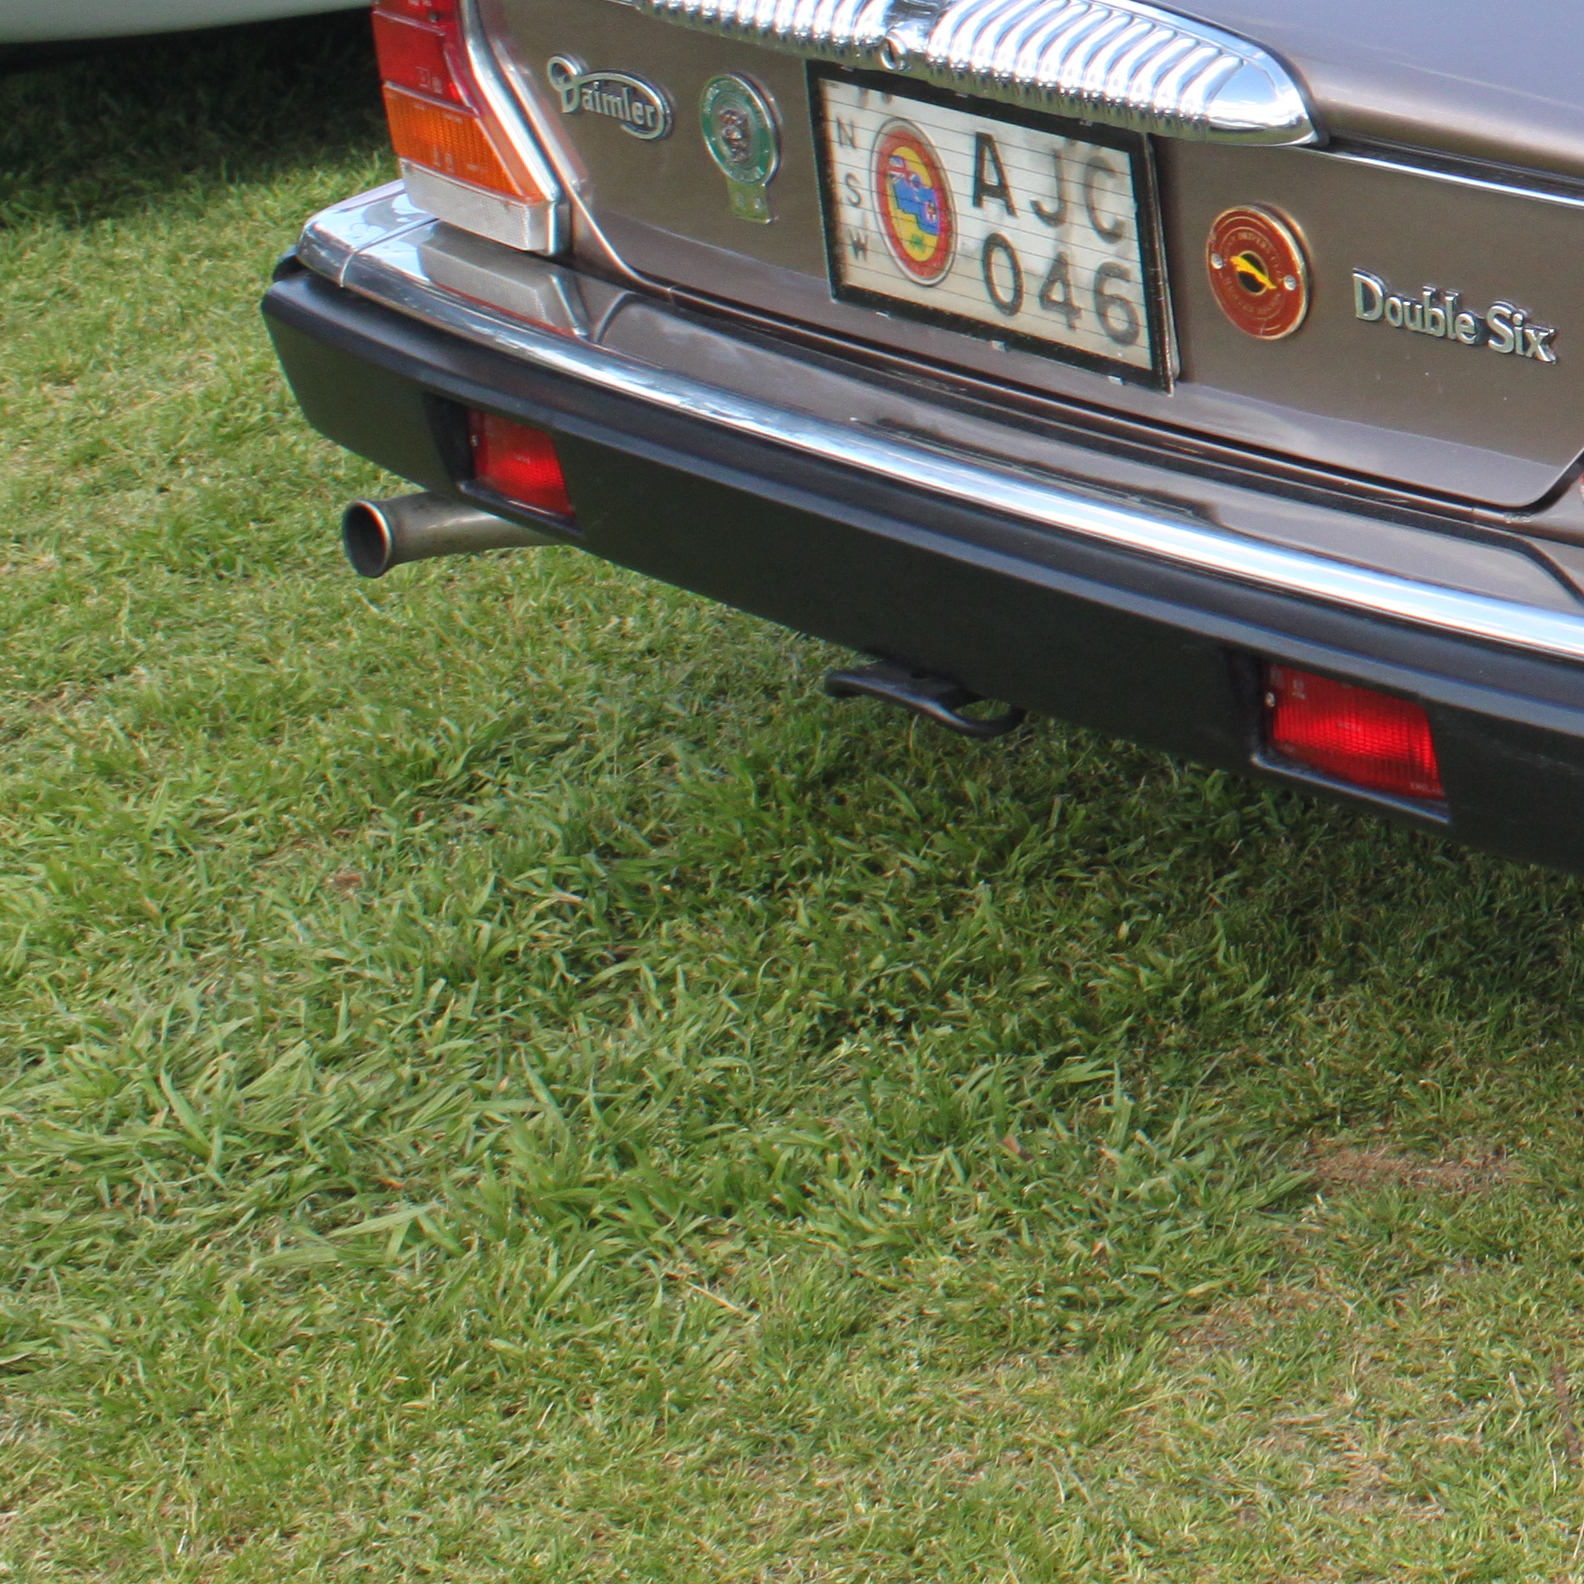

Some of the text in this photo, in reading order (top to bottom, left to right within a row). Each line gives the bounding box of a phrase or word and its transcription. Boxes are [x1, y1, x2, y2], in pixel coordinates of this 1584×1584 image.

[546, 54, 670, 141] Daimler
[971, 129, 1128, 245] AJC
[980, 231, 1141, 347] 046
[1352, 269, 1478, 346] Double
[1486, 300, 1559, 365] Six
